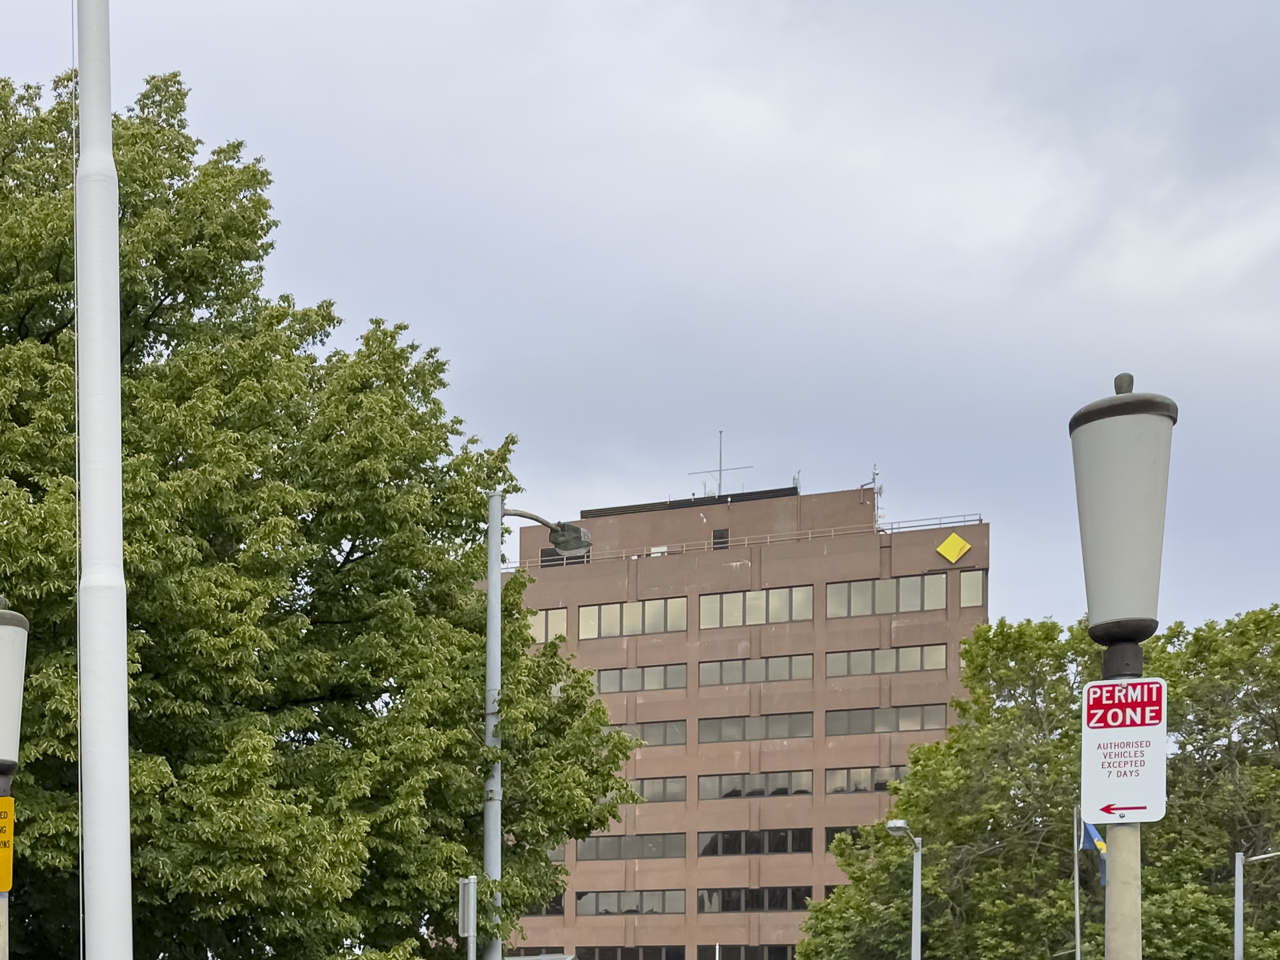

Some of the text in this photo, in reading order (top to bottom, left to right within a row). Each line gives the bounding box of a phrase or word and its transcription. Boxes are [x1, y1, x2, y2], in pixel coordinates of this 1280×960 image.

[1089, 684, 1160, 705] PERMIT
[1089, 706, 1160, 727] ZONE
[1096, 740, 1151, 750] AUTHORISED
[1102, 750, 1145, 759] VEHICLES
[1101, 760, 1146, 769] EXCEPTED
[1116, 769, 1140, 778] DAYS
